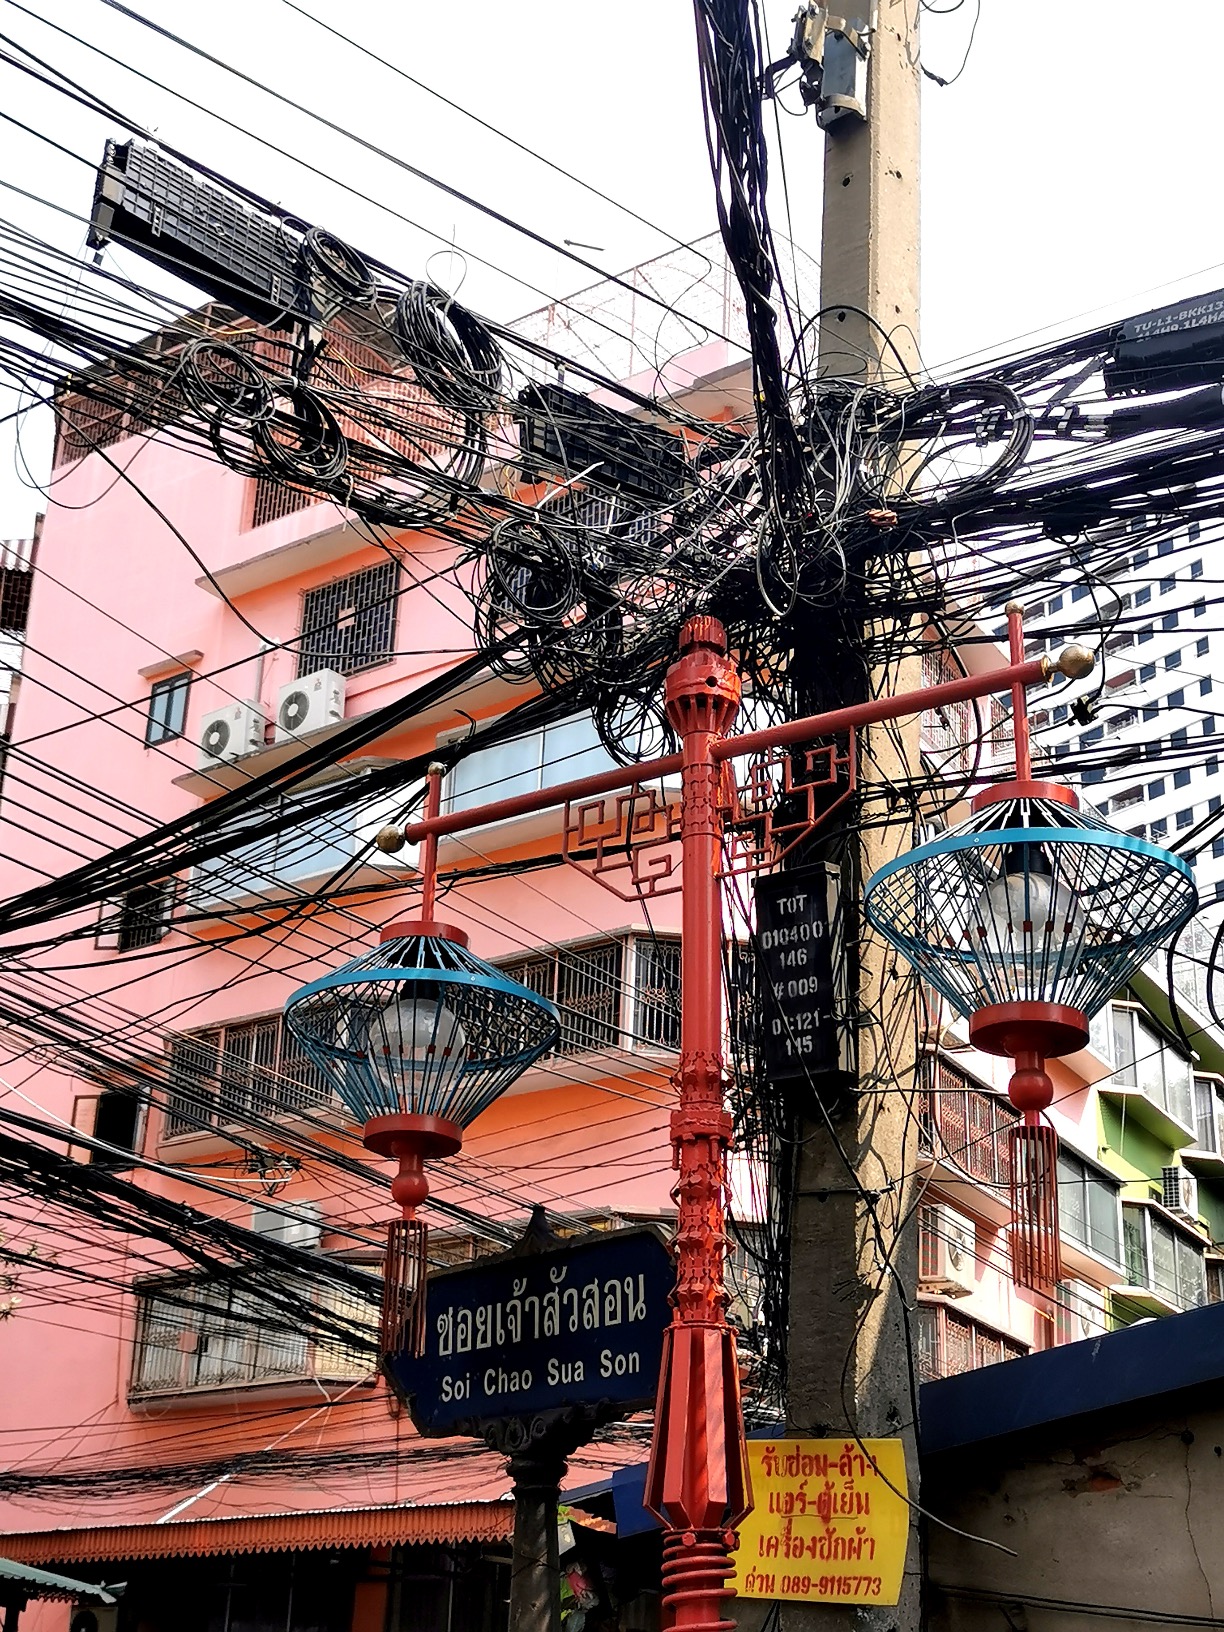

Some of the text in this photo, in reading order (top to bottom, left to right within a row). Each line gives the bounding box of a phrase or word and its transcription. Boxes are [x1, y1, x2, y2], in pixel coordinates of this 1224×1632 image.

[776, 894, 808, 915] TOT
[780, 948, 807, 969] 146
[436, 1266, 647, 1357] ซอยเจ้าสัวสอน
[440, 1349, 640, 1403] Soi Chao Sua Son
[758, 1519, 876, 1561] เครื่องซักผ้า
[780, 1575, 882, 1597] 089-9115773
